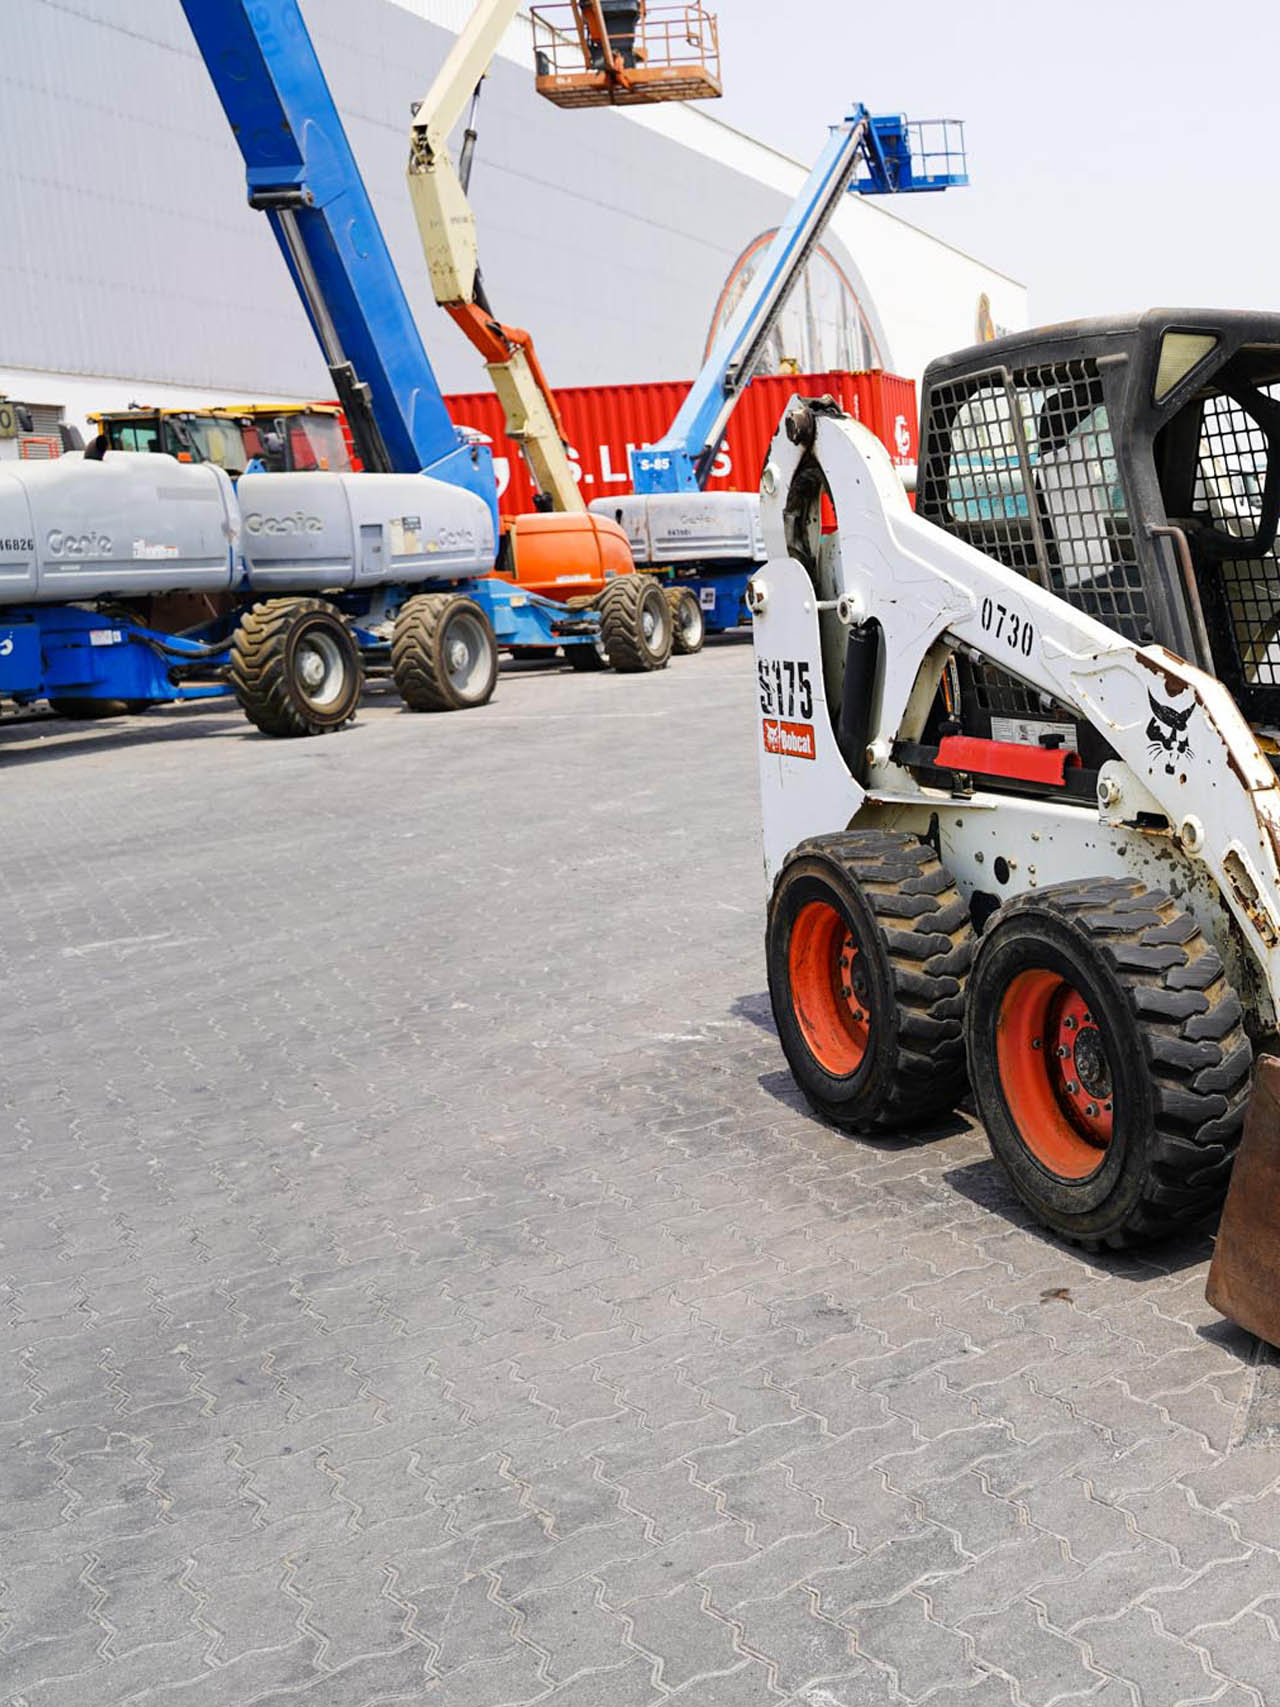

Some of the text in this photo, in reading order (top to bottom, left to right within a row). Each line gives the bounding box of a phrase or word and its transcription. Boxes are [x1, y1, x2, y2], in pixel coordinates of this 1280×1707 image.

[640, 458, 671, 471] S-85
[247, 511, 325, 536] Genie
[48, 529, 113, 558] Genie
[981, 597, 1034, 657] 0730
